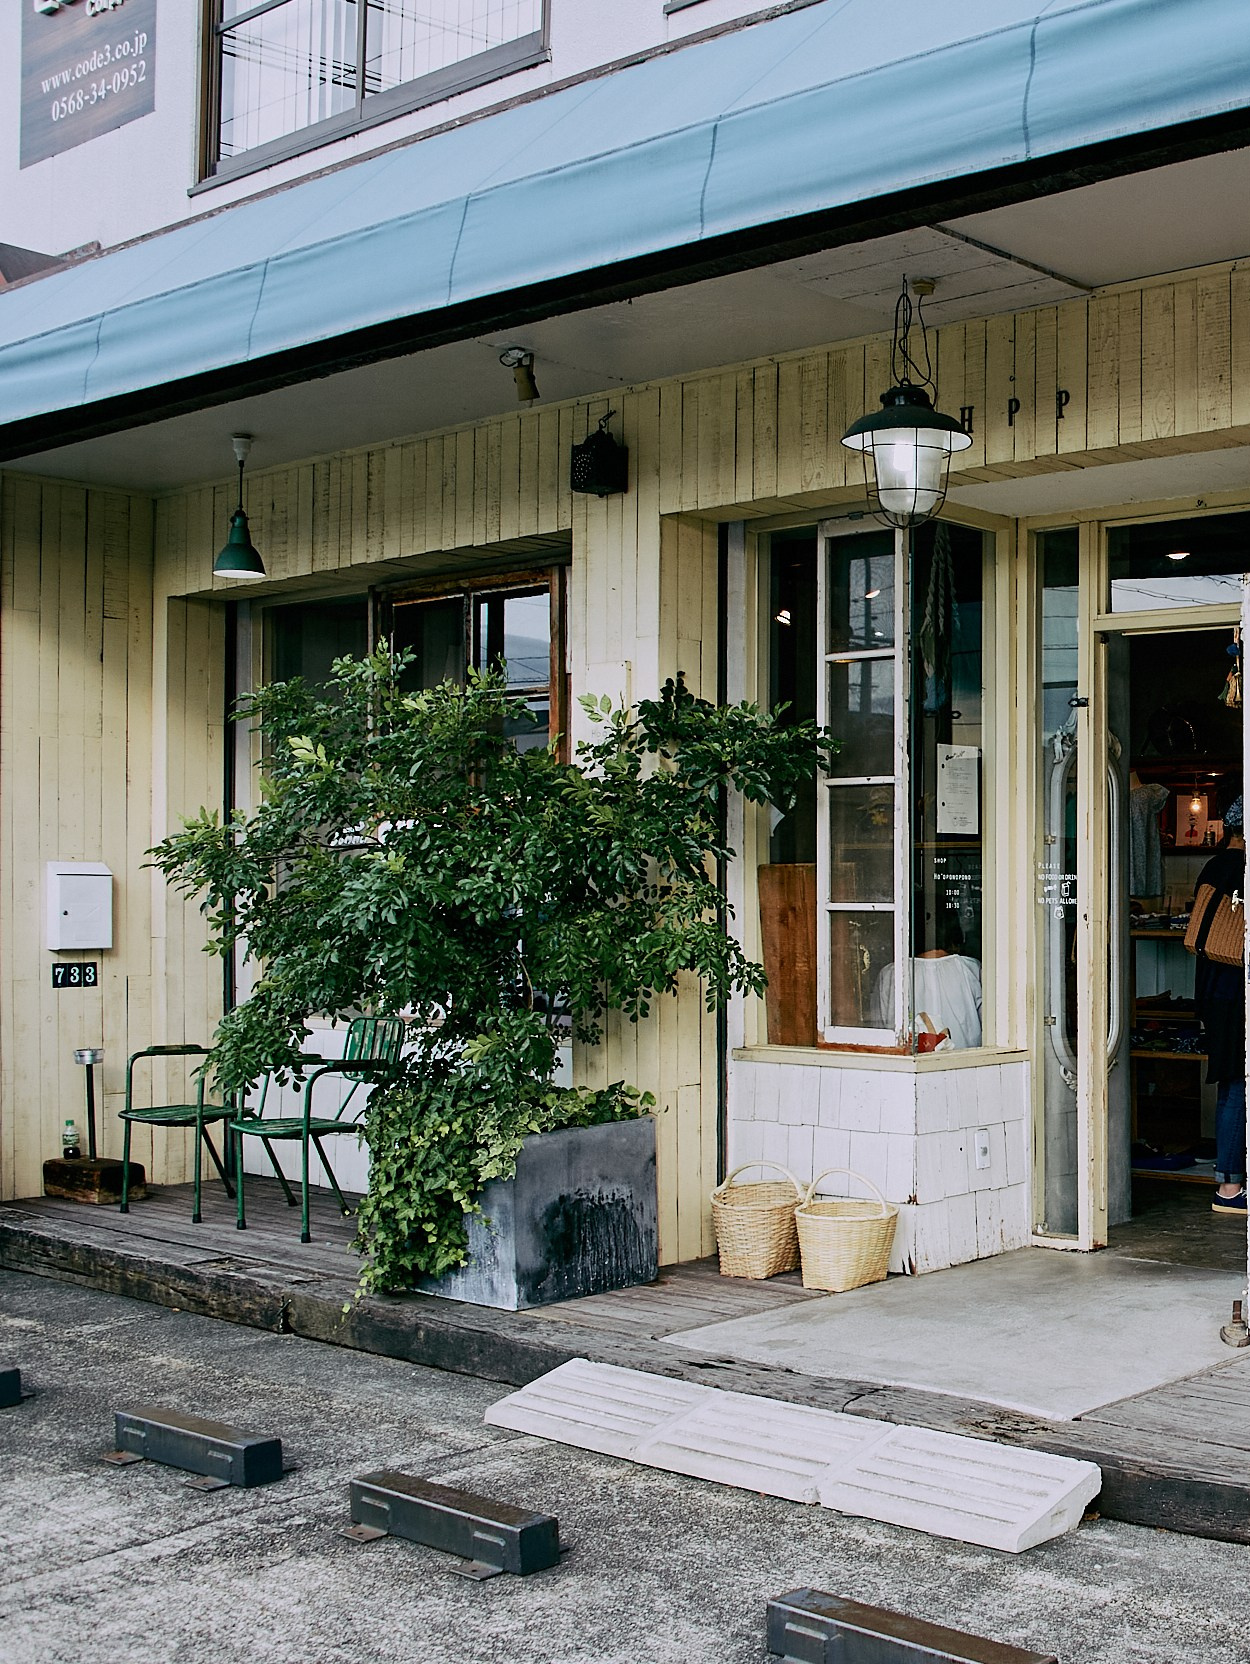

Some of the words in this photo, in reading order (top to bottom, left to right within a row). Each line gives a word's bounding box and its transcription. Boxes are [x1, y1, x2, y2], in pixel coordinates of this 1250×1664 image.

[41, 30, 148, 93] www.code3.co.jp
[51, 60, 146, 121] 0568-34-0952
[55, 966, 95, 984] 733
